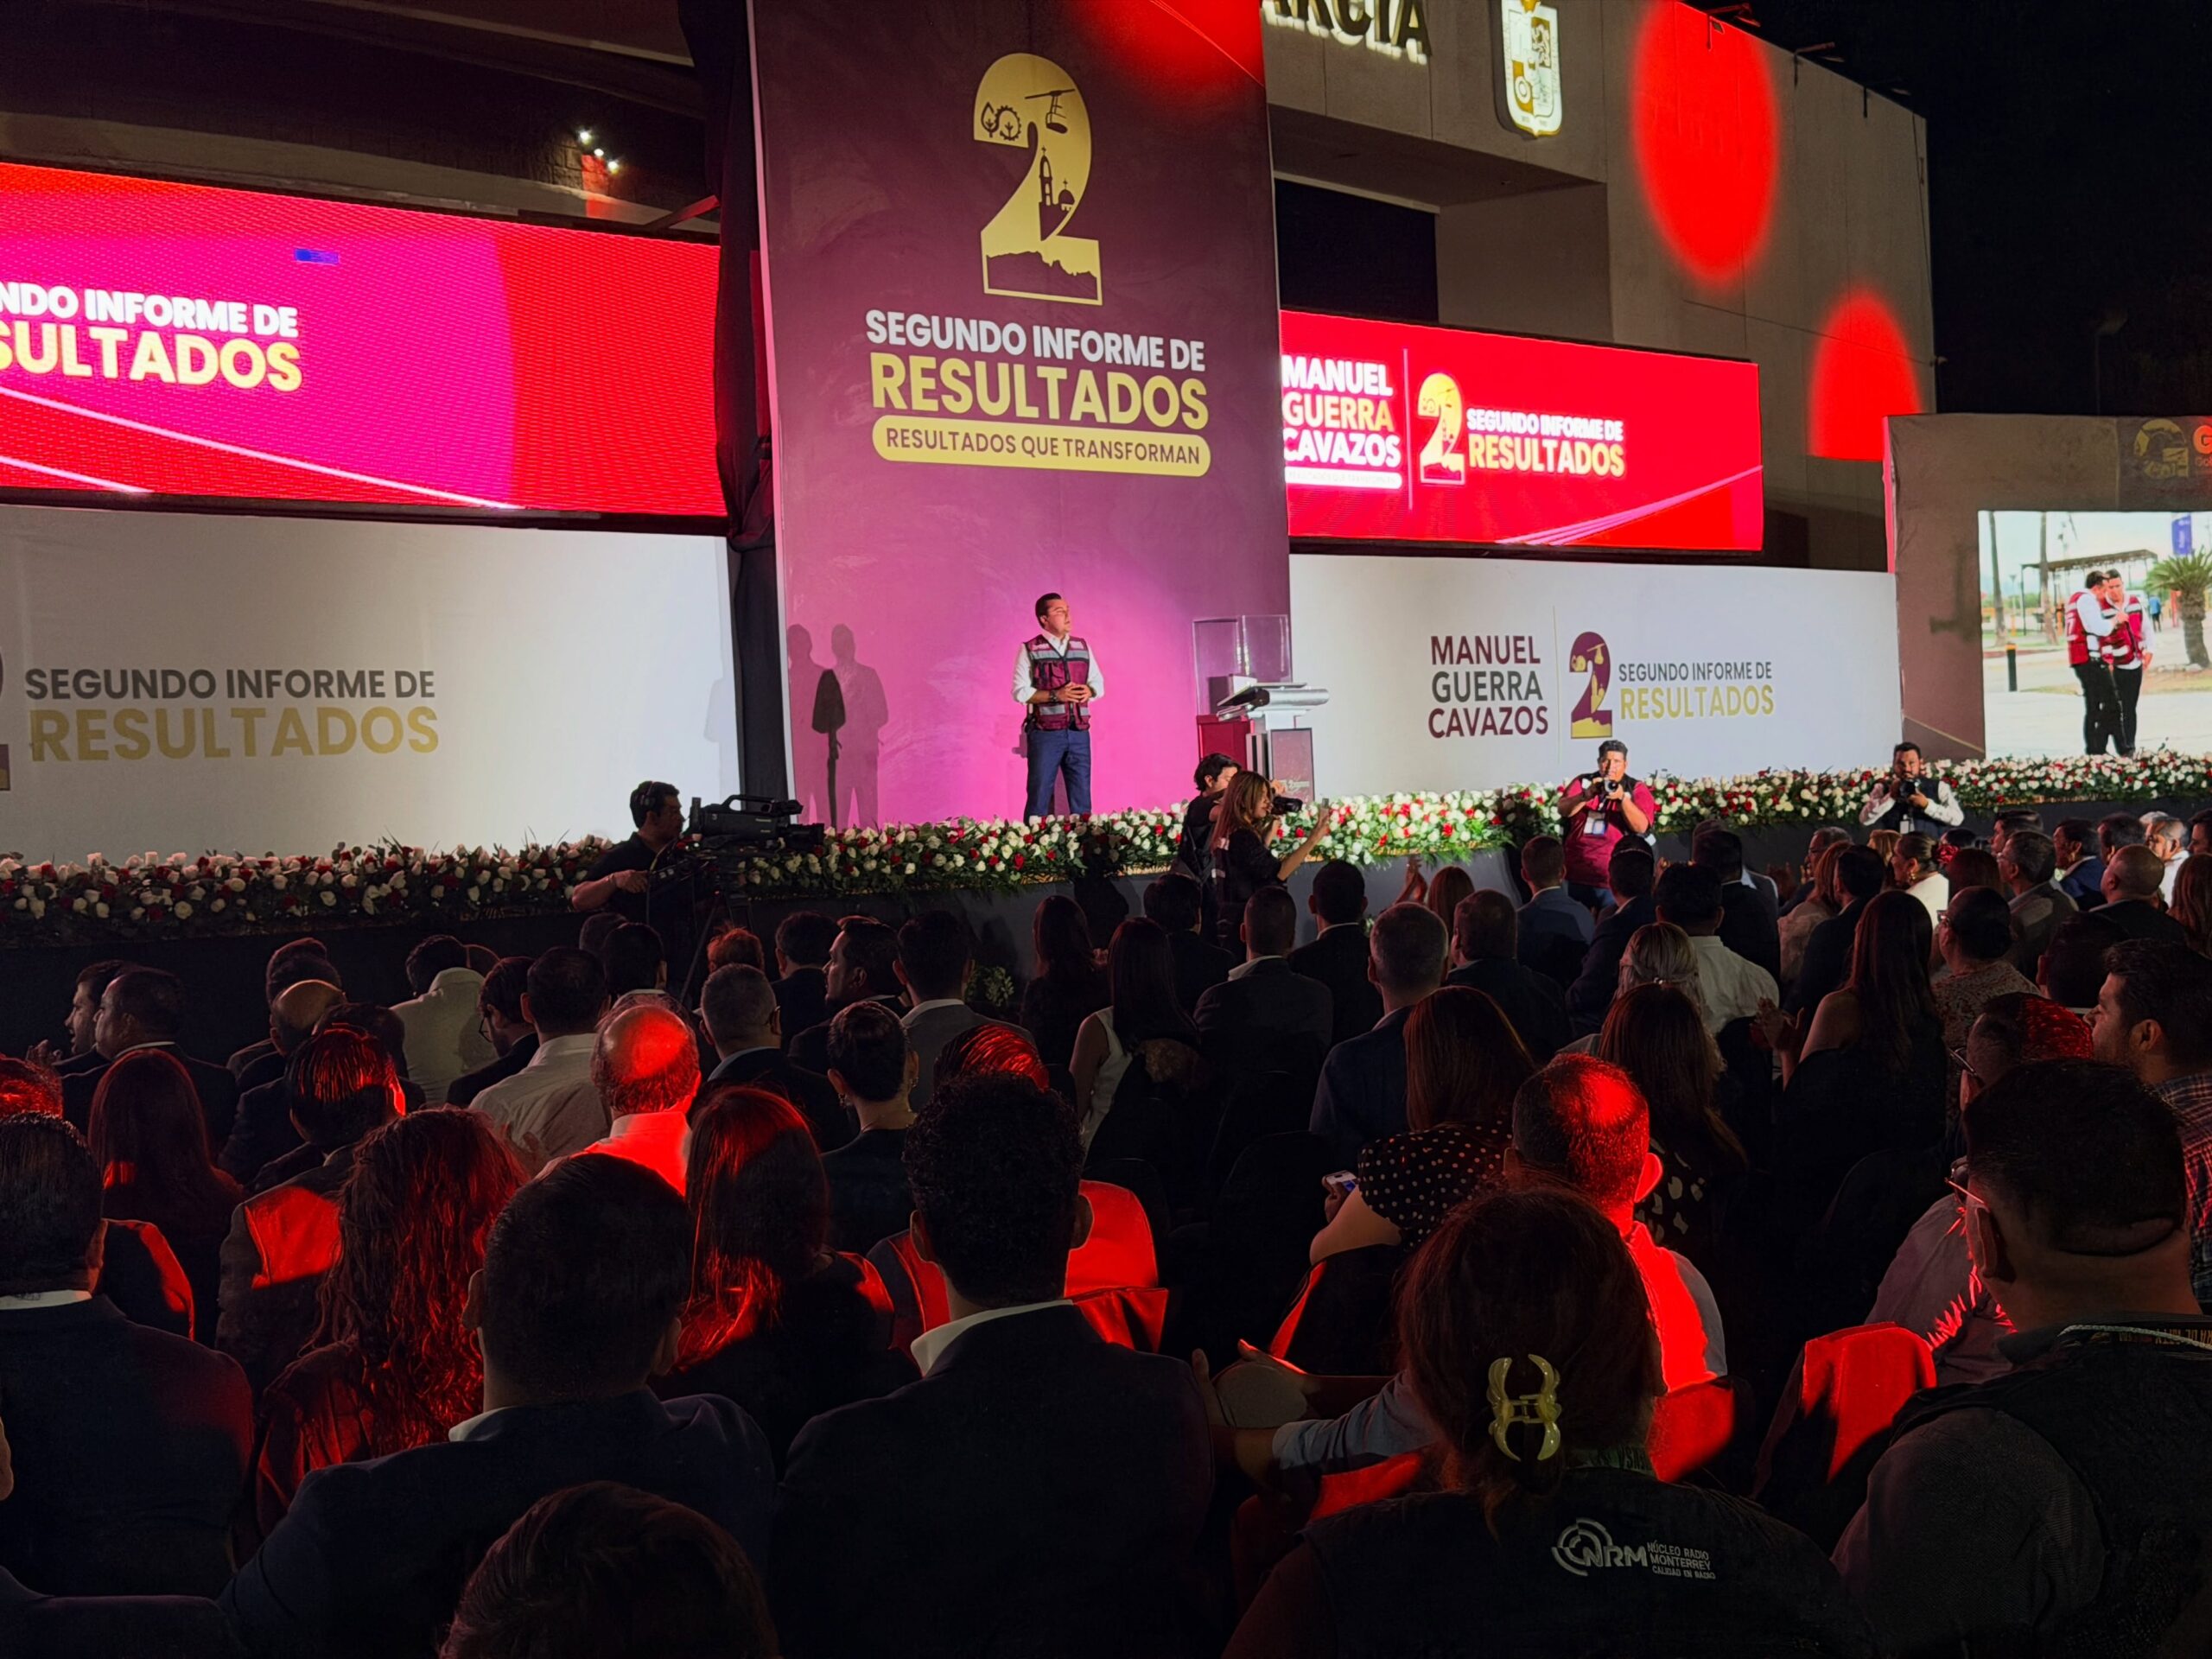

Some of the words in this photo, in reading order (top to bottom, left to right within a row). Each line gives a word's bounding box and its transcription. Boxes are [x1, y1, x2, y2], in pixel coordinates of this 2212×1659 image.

[84, 289, 248, 334] INFORME
[253, 304, 299, 337] DE
[865, 309, 1027, 355] SEGUNDO
[1033, 326, 1165, 368] INFORME
[1170, 339, 1205, 372] DE
[869, 352, 1209, 430] RESULTADOS
[1281, 355, 1393, 397] MANUEL
[1281, 391, 1395, 432] GUERRA
[1466, 408, 1540, 435] SEGUNDO
[1541, 415, 1604, 441] INFORME
[1605, 420, 1624, 442] DE
[887, 428, 1016, 454] RESULTADOS
[1022, 435, 1058, 457] QUE
[1064, 438, 1200, 465] TRANSFORMAN
[1283, 429, 1402, 467] CAVAZOS
[1468, 434, 1624, 477] RESULTADOS
[1431, 635, 1541, 665] MANUEL
[25, 668, 217, 700] SEGUNDO
[226, 670, 385, 698] INFORME
[395, 671, 435, 698] DE
[1432, 671, 1543, 702] GUERRA
[1618, 663, 1689, 682] SEGUNDO
[1693, 662, 1751, 681] INFORME
[1756, 662, 1772, 679] DE
[1620, 684, 1774, 720] RESULTADOS
[30, 706, 439, 762] RESULTADOS
[1428, 706, 1548, 739] CAVAZOS
[1581, 1545, 1649, 1568] NRM
[1647, 1539, 1681, 1557] NÚCLEO
[1683, 1548, 1709, 1561] RADIO
[1649, 1554, 1712, 1571] MONTERREY
[1652, 1566, 1681, 1577] CALIDAD
